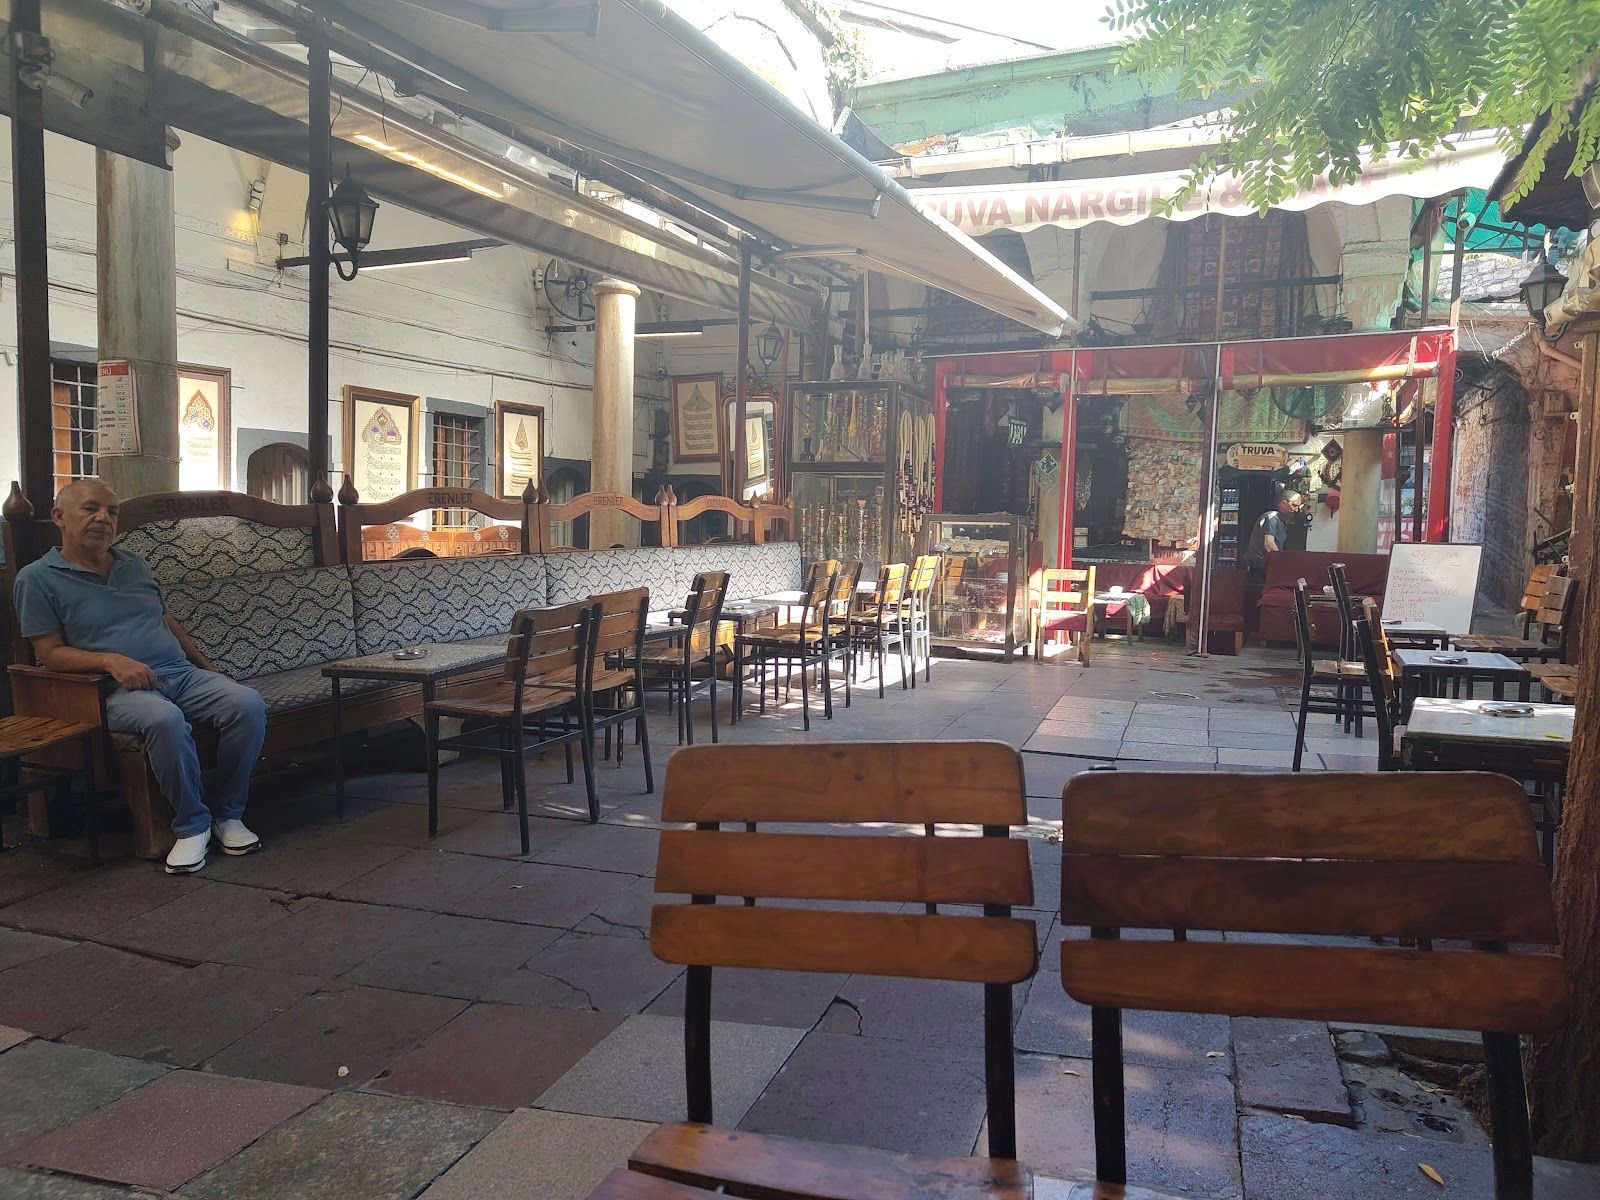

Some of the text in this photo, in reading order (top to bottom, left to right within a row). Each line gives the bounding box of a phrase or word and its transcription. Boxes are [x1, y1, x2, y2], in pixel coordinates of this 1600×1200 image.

[927, 197, 1013, 227] UVA
[1219, 176, 1248, 209] &
[1241, 446, 1275, 455] TRUVA
[427, 492, 473, 505] ERENLER
[593, 496, 624, 507] ERENLER
[1409, 610, 1425, 618] 120
